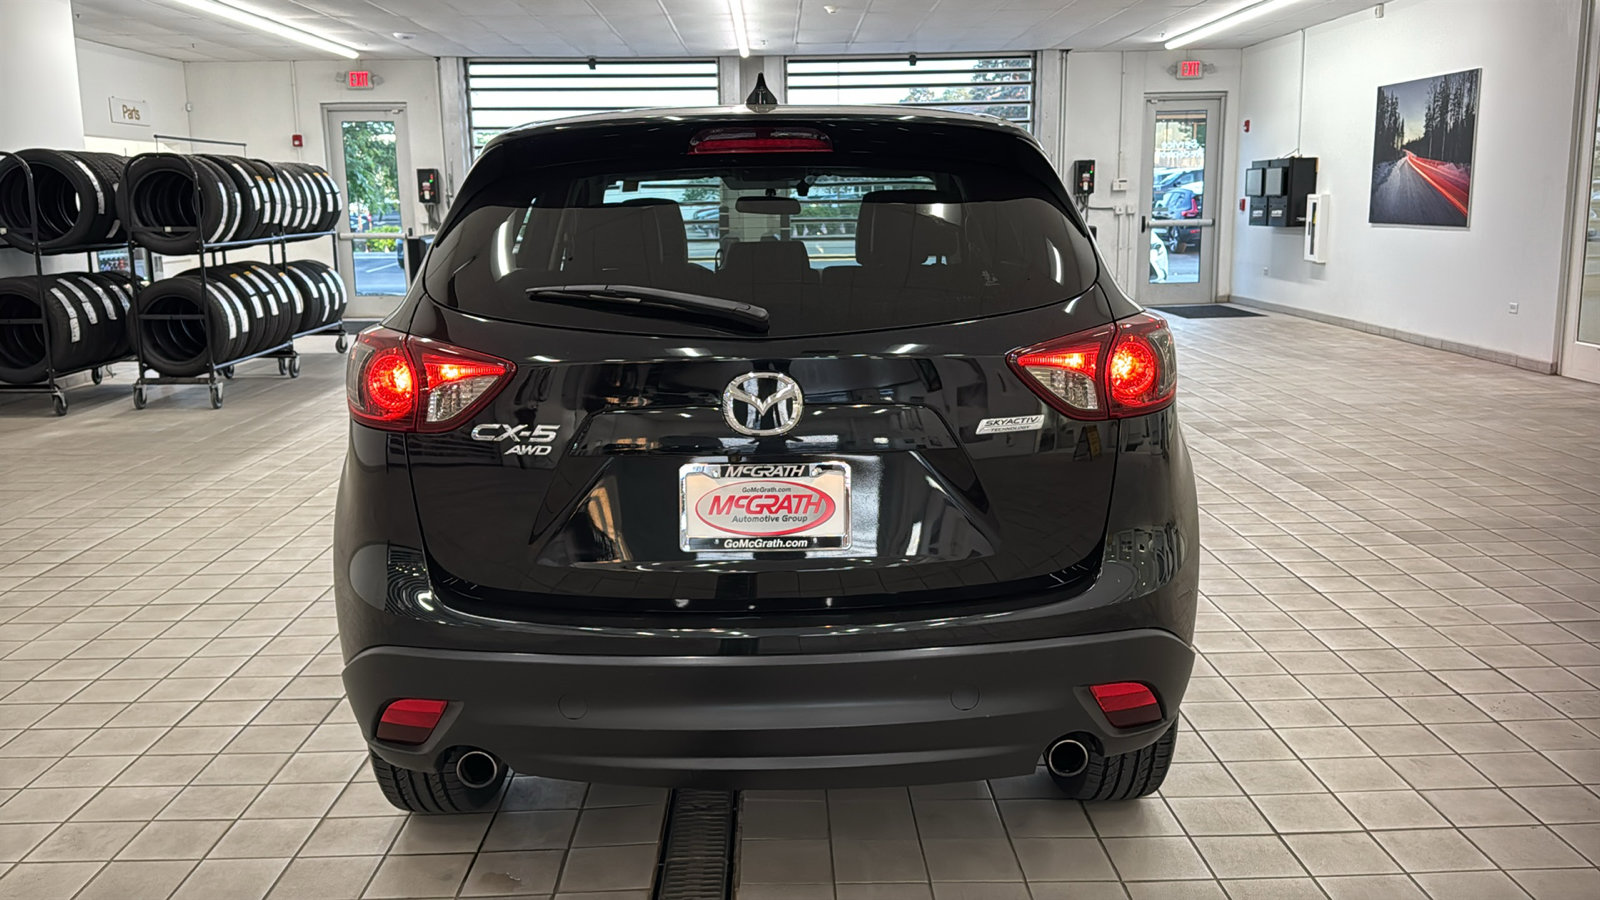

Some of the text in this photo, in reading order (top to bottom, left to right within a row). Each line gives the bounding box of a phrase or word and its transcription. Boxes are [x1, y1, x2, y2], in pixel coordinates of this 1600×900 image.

[1181, 61, 1200, 77] EXIT
[349, 71, 369, 87] EXIT
[122, 104, 141, 121] Parts
[985, 416, 1039, 426] SKYACTIV
[470, 423, 561, 443] CX-5
[503, 444, 553, 456] AWD
[731, 515, 808, 523] Automotive Group
[723, 538, 808, 549] GoMcGrath.com
